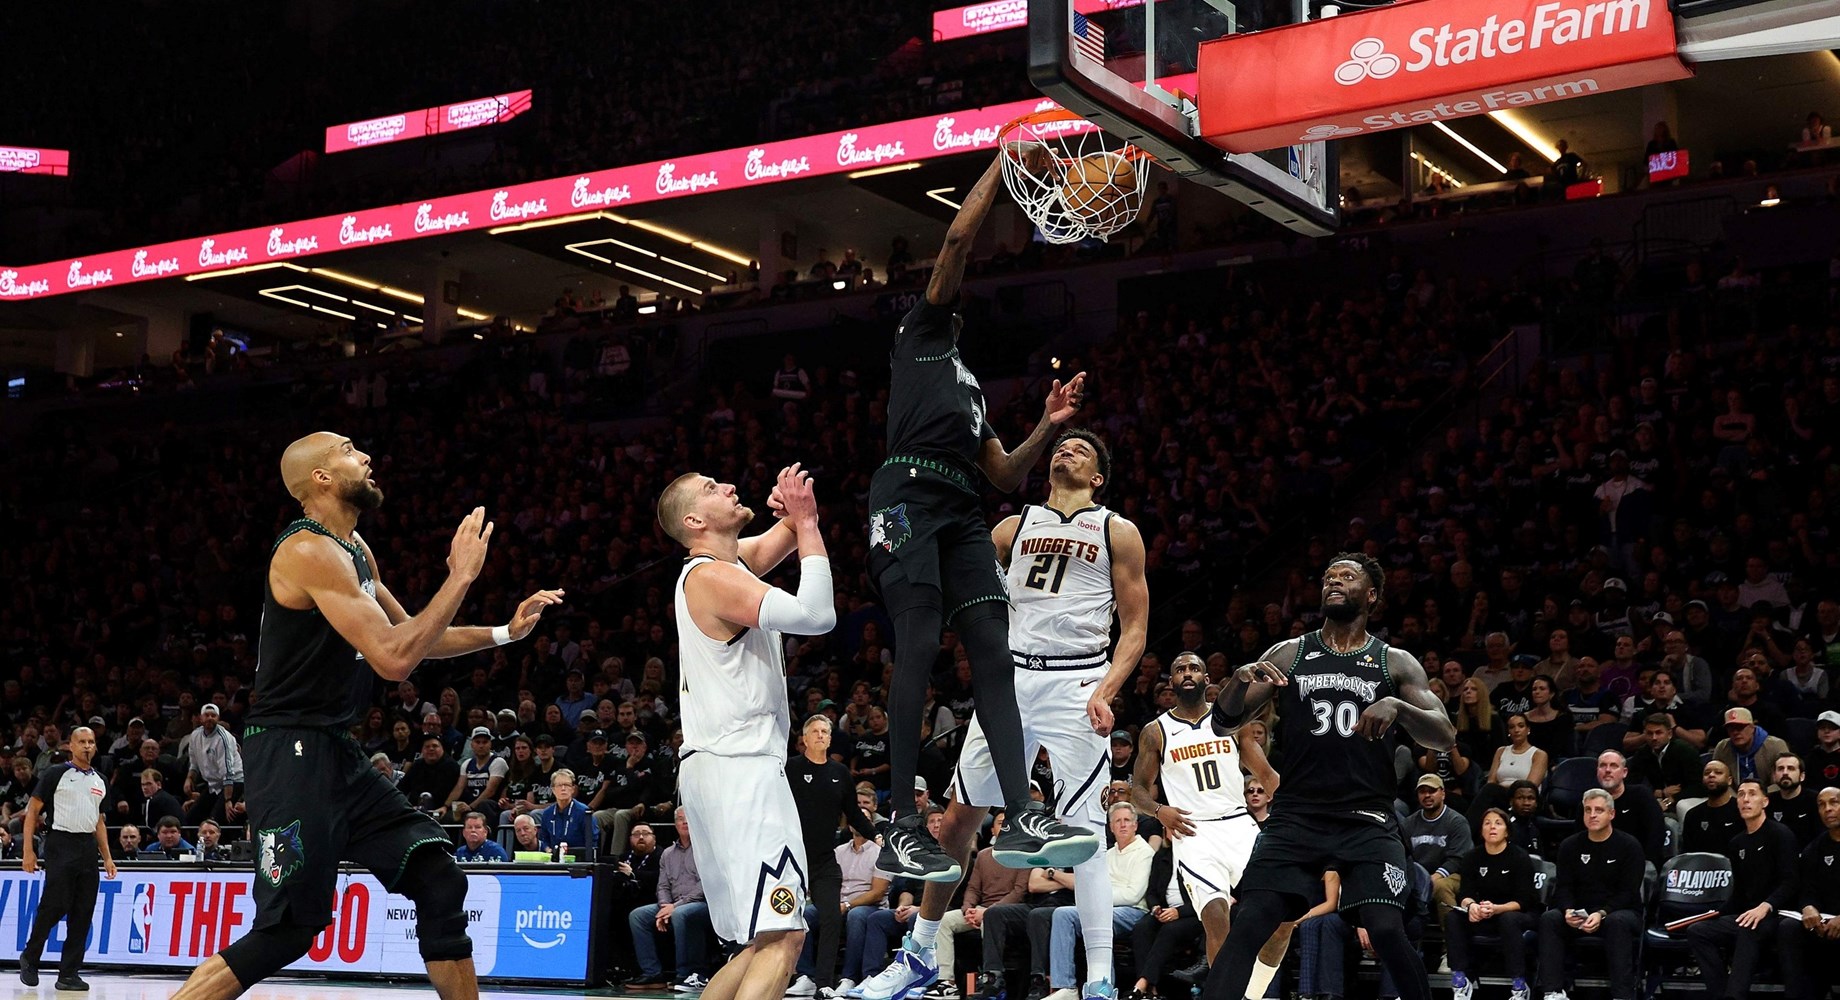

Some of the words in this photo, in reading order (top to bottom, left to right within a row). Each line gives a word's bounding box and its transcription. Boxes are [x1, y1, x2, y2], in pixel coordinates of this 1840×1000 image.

[350, 118, 403, 135] STANDARD
[1077, 519, 1101, 532] ibotta
[1021, 537, 1100, 564] NUGGETS
[1025, 554, 1070, 594] 21
[1356, 660, 1380, 669] sezzle
[1294, 672, 1381, 703] TIMBERWOLVES
[1310, 697, 1359, 738] 30
[1169, 739, 1231, 764] NUGGETS
[1191, 759, 1222, 792] 10
[1676, 869, 1733, 889] PLAYOFFS
[1681, 888, 1704, 897] Google
[168, 881, 248, 958] THE
[386, 908, 409, 921] NEW
[515, 904, 573, 933] prime
